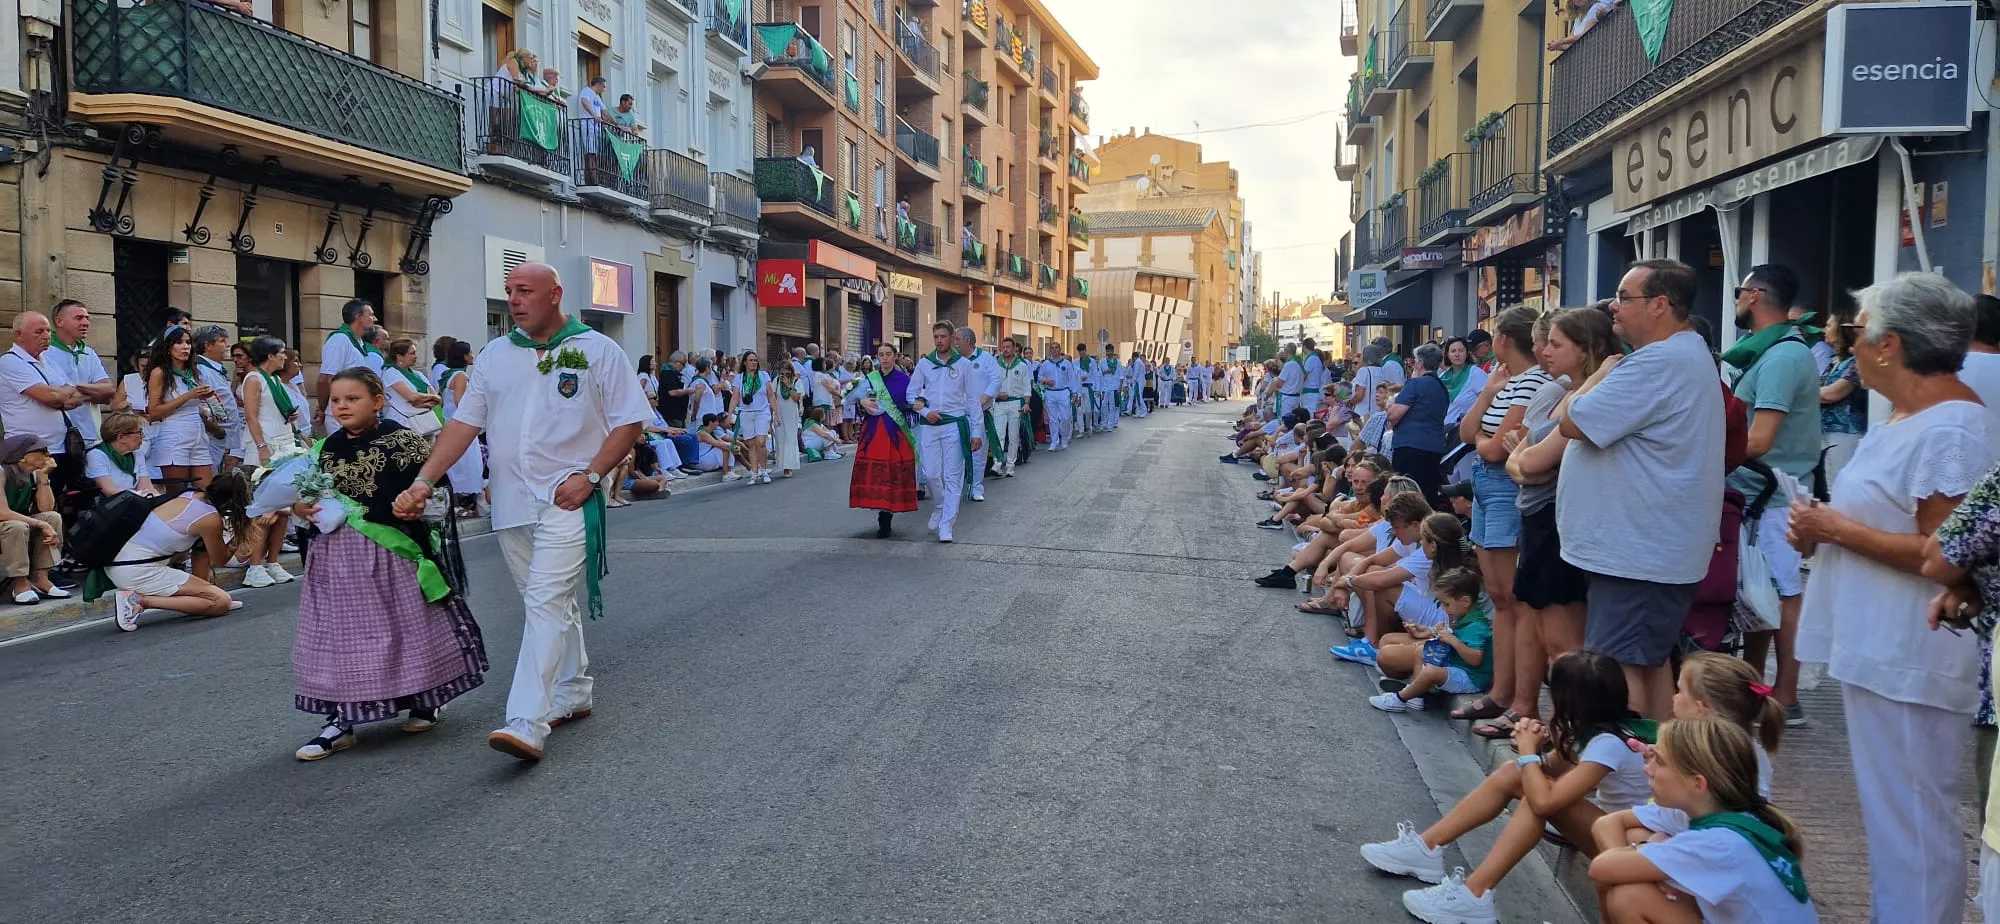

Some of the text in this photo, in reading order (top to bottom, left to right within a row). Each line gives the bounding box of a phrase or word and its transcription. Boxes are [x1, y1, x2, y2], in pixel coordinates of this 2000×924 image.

[1852, 56, 1958, 81] esencia
[1633, 142, 1849, 229] esencia esencia
[1355, 290, 1382, 298] Aragón
